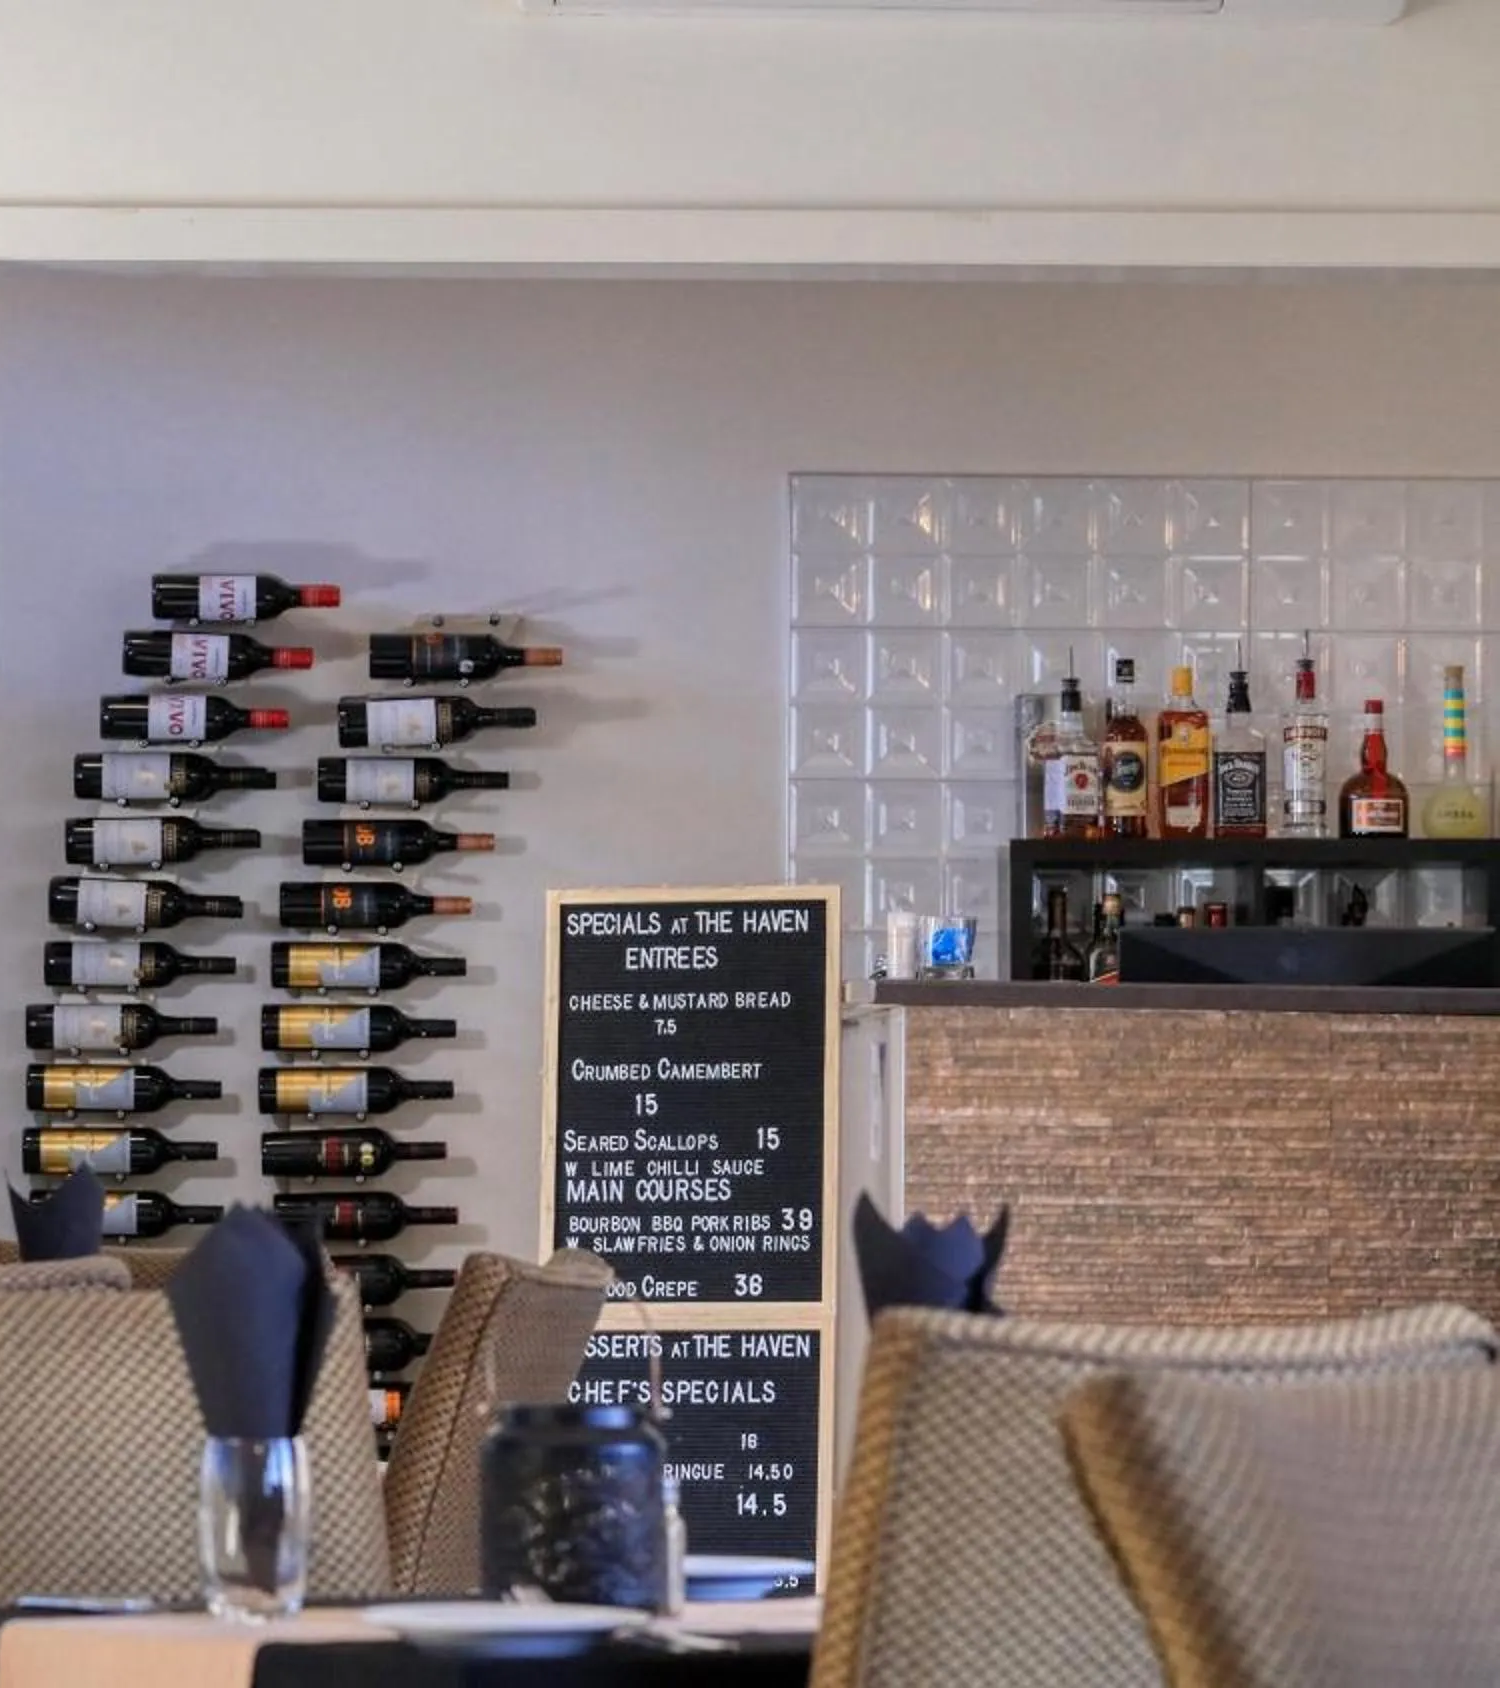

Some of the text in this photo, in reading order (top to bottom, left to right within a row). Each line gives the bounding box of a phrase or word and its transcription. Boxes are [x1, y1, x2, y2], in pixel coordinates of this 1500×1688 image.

[566, 909, 809, 936] SPECIALS AT THE HAVEN
[625, 945, 719, 970] ENTREES
[568, 991, 791, 1012] CHEESE & MUSTARD BREAD
[654, 1018, 677, 1036] 7.5
[571, 1057, 763, 1081] CRUMBED CAMEMBERT
[635, 1092, 659, 1116] 15
[563, 1127, 781, 1152] SEARED SCALLOPS 15
[564, 1158, 765, 1177] W LIME CHILLI SAUCE
[566, 1178, 732, 1204] MAIN COURSES
[569, 1207, 813, 1234] BOURBON BBQ PORK RIBS 39
[693, 1235, 705, 1252] &
[709, 1235, 756, 1253] ONION
[762, 1234, 811, 1252] RINGS
[641, 1274, 699, 1298] CREPE
[583, 1333, 811, 1360] SSERTS AT THE HAVEN
[567, 1379, 776, 1405] CHEF'S SPECIALS
[663, 1463, 794, 1481] RINGUE 14.50
[736, 1492, 787, 1517] 14.5
